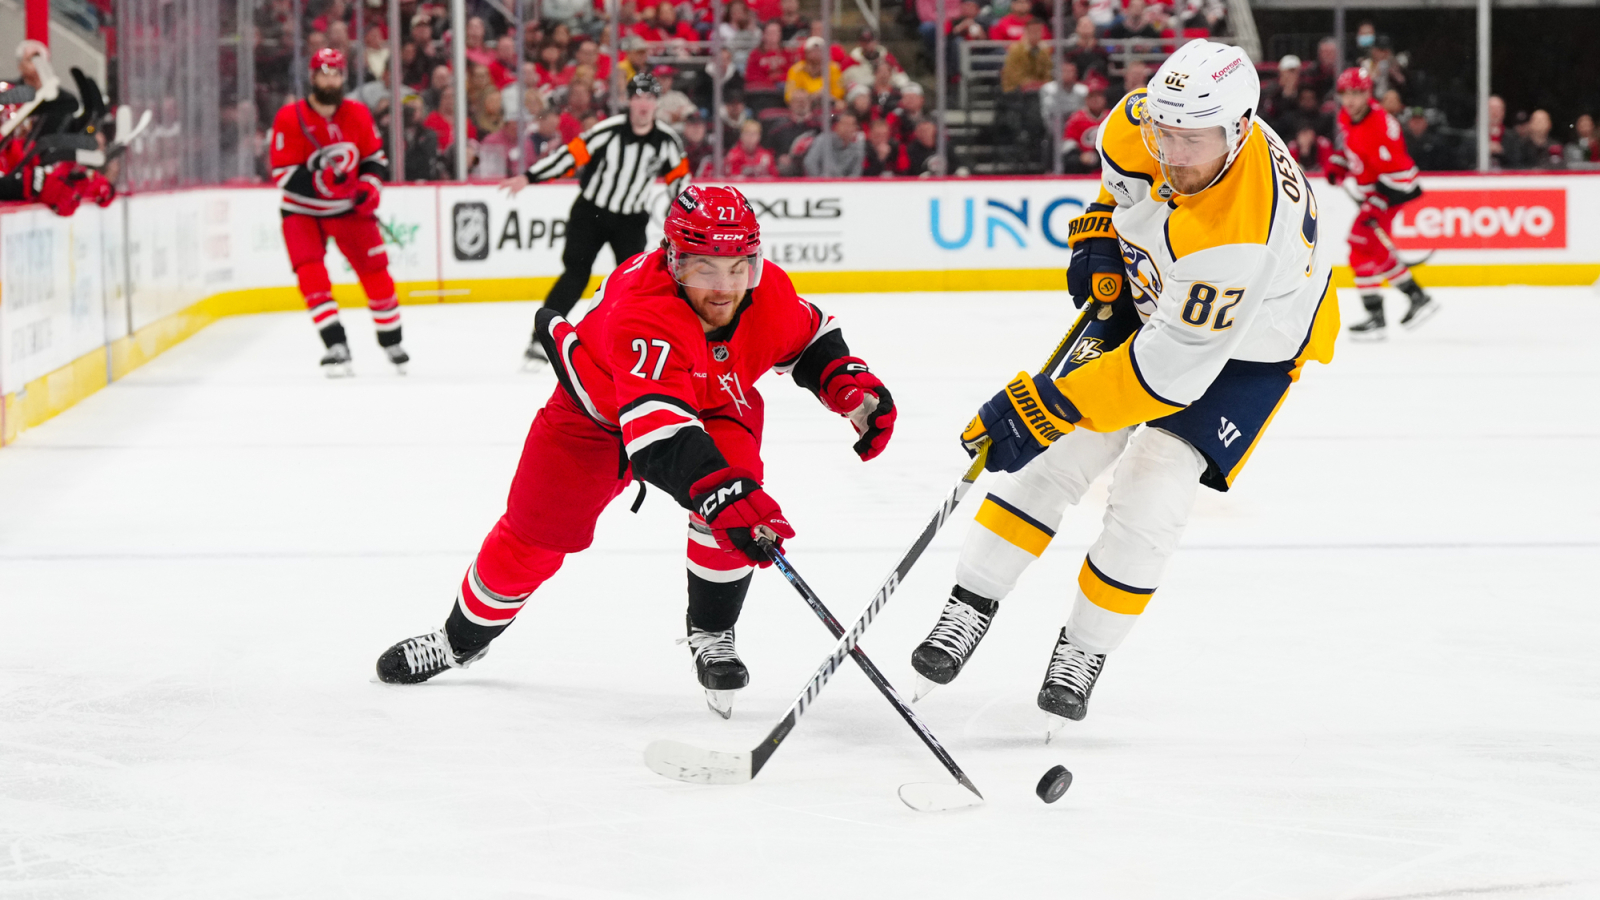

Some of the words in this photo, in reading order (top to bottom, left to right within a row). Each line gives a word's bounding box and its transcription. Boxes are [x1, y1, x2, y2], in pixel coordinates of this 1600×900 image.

[1211, 58, 1242, 80] Koorsen
[1157, 98, 1185, 108] WARRIOR
[717, 206, 735, 221] 27
[757, 198, 841, 219] XUS
[1391, 206, 1554, 239] Lenovo
[712, 233, 744, 241] CCM
[771, 243, 843, 263] LEXUS
[1180, 281, 1247, 331] 82
[630, 338, 671, 381] 27
[774, 556, 795, 581] TRUE
